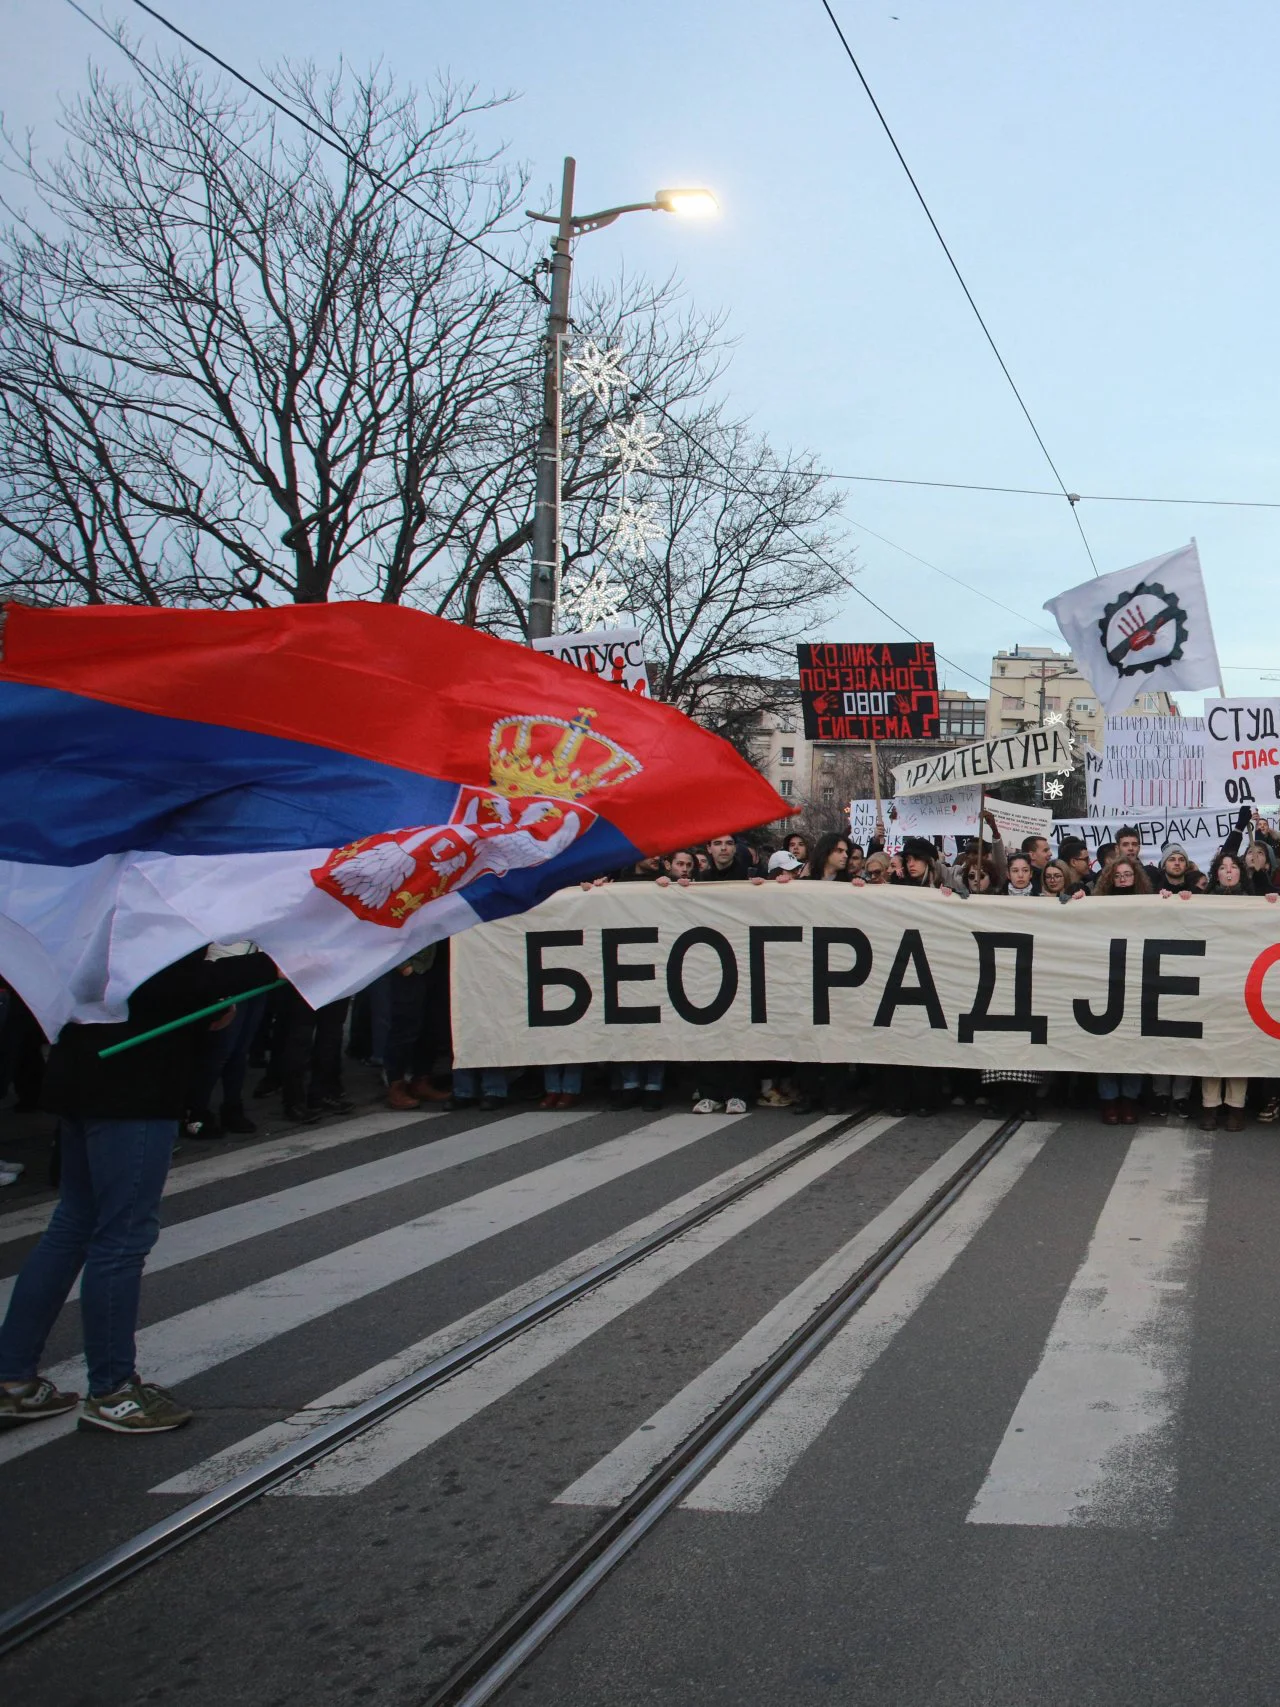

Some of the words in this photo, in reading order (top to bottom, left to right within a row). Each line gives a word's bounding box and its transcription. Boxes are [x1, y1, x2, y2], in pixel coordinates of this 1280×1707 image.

[810, 643, 895, 667] КОЛИКА
[909, 643, 936, 666] ЈЕ
[800, 666, 937, 691] ПОУЗДАНОСТ
[843, 691, 896, 715] ОВОГ
[817, 715, 912, 739] СИСТЕМА
[1232, 747, 1280, 771] ГЛАС
[1224, 777, 1256, 804] ОД
[524, 926, 1048, 1045] БЕОГРАД
[1072, 938, 1207, 1040] ЈЕ
